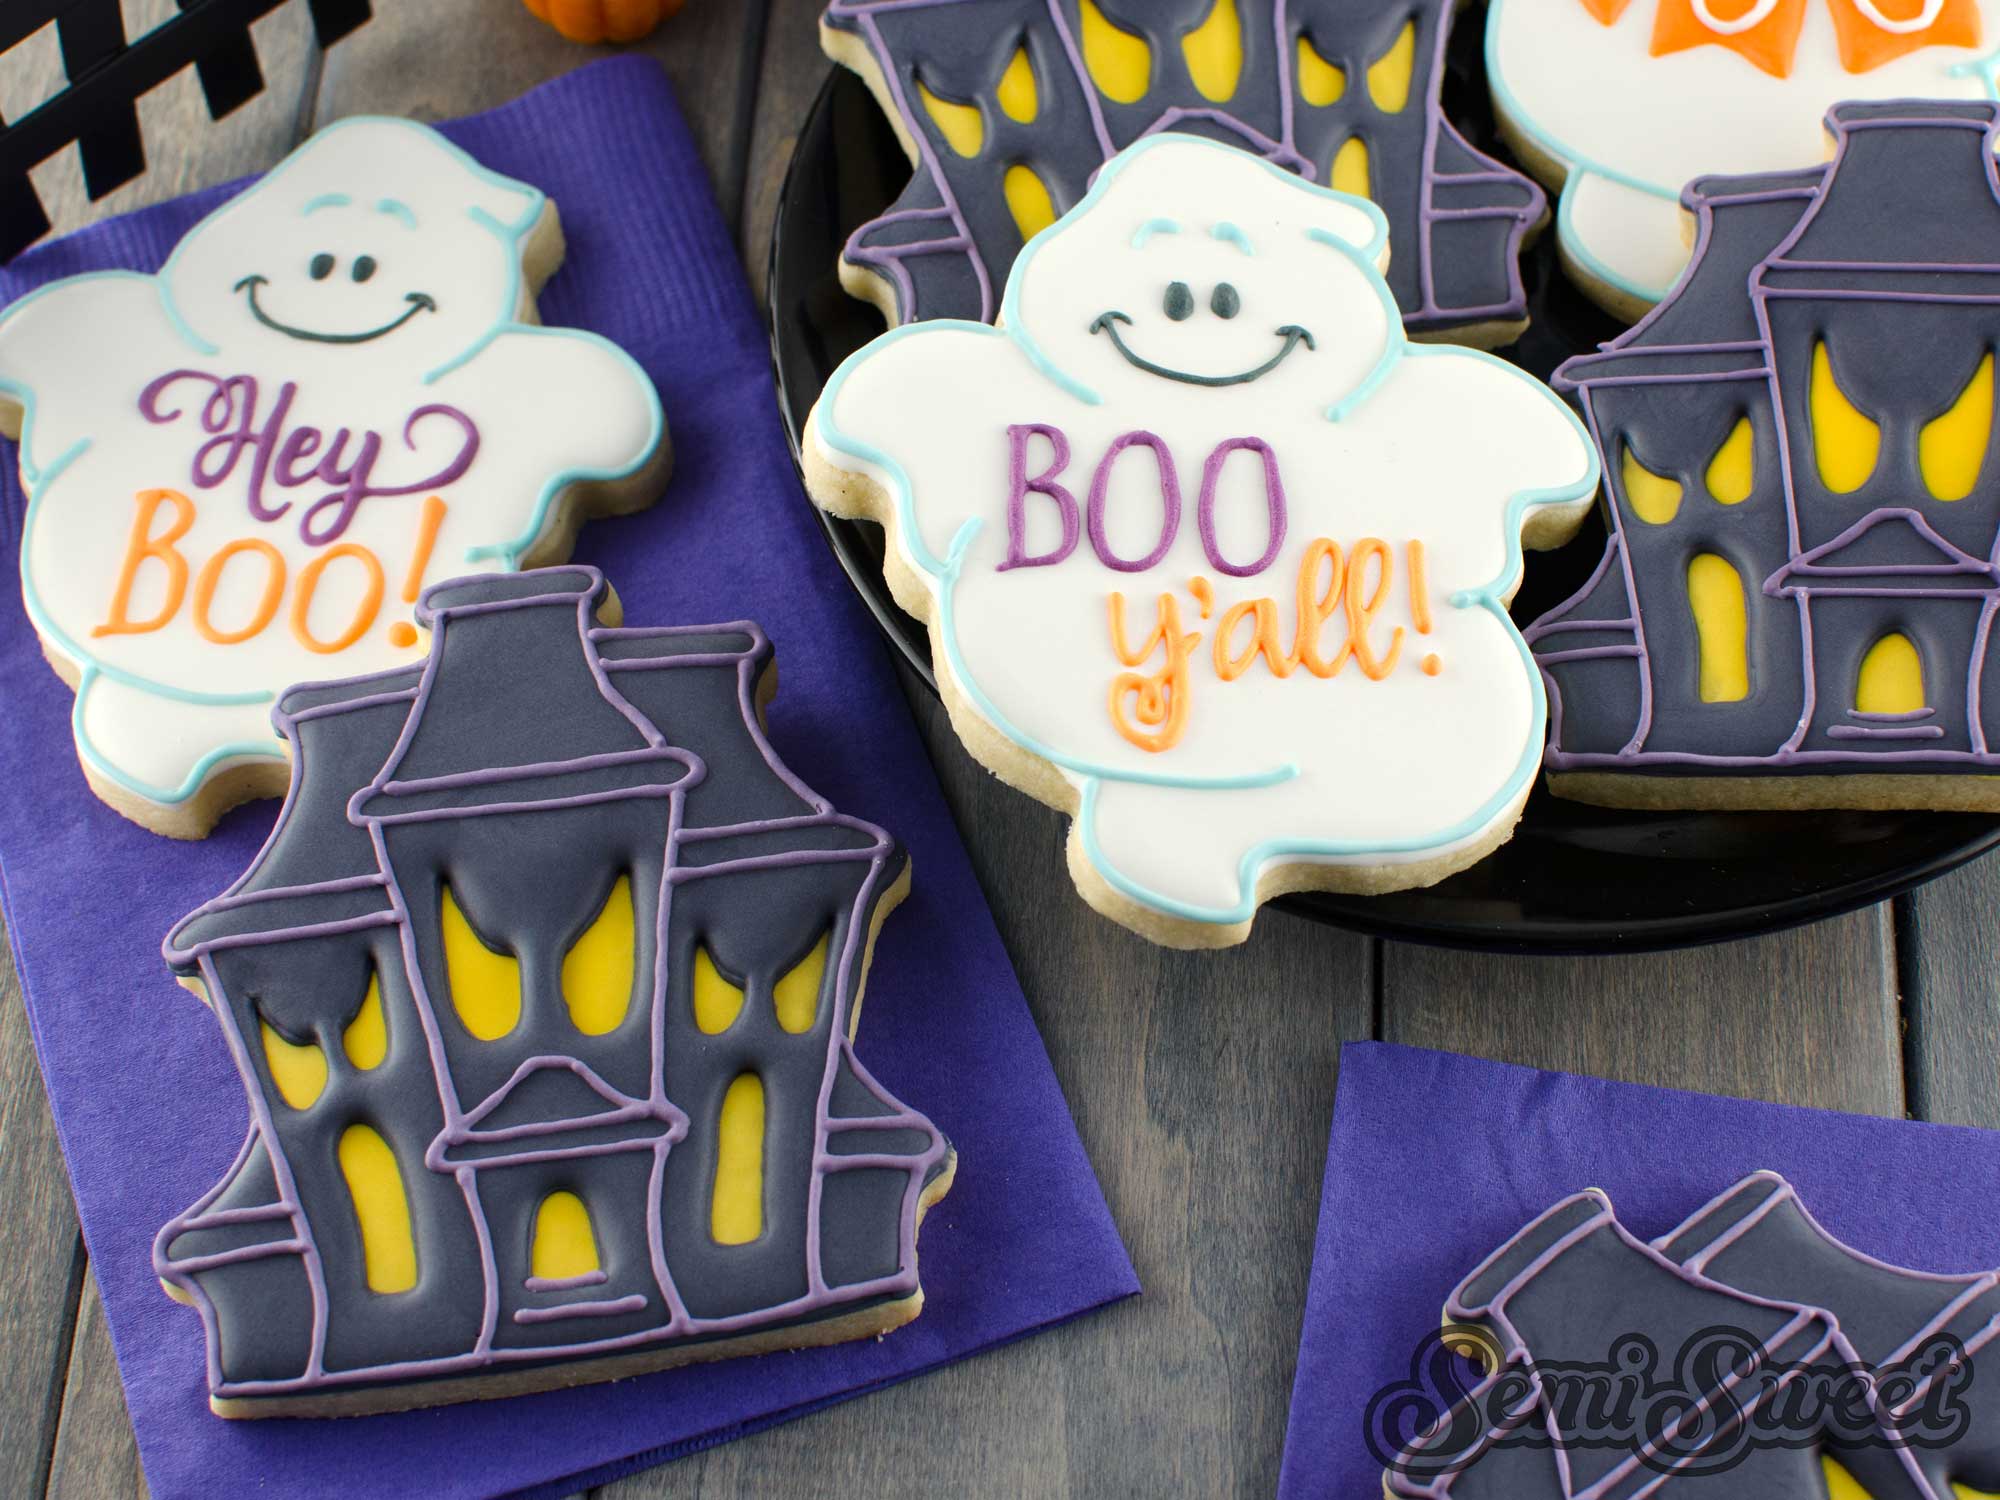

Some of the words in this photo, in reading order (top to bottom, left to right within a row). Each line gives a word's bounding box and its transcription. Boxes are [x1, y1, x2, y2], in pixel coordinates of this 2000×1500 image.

[138, 369, 480, 546] Hey
[995, 423, 1288, 577] BOO
[1107, 537, 1442, 753] y'all!
